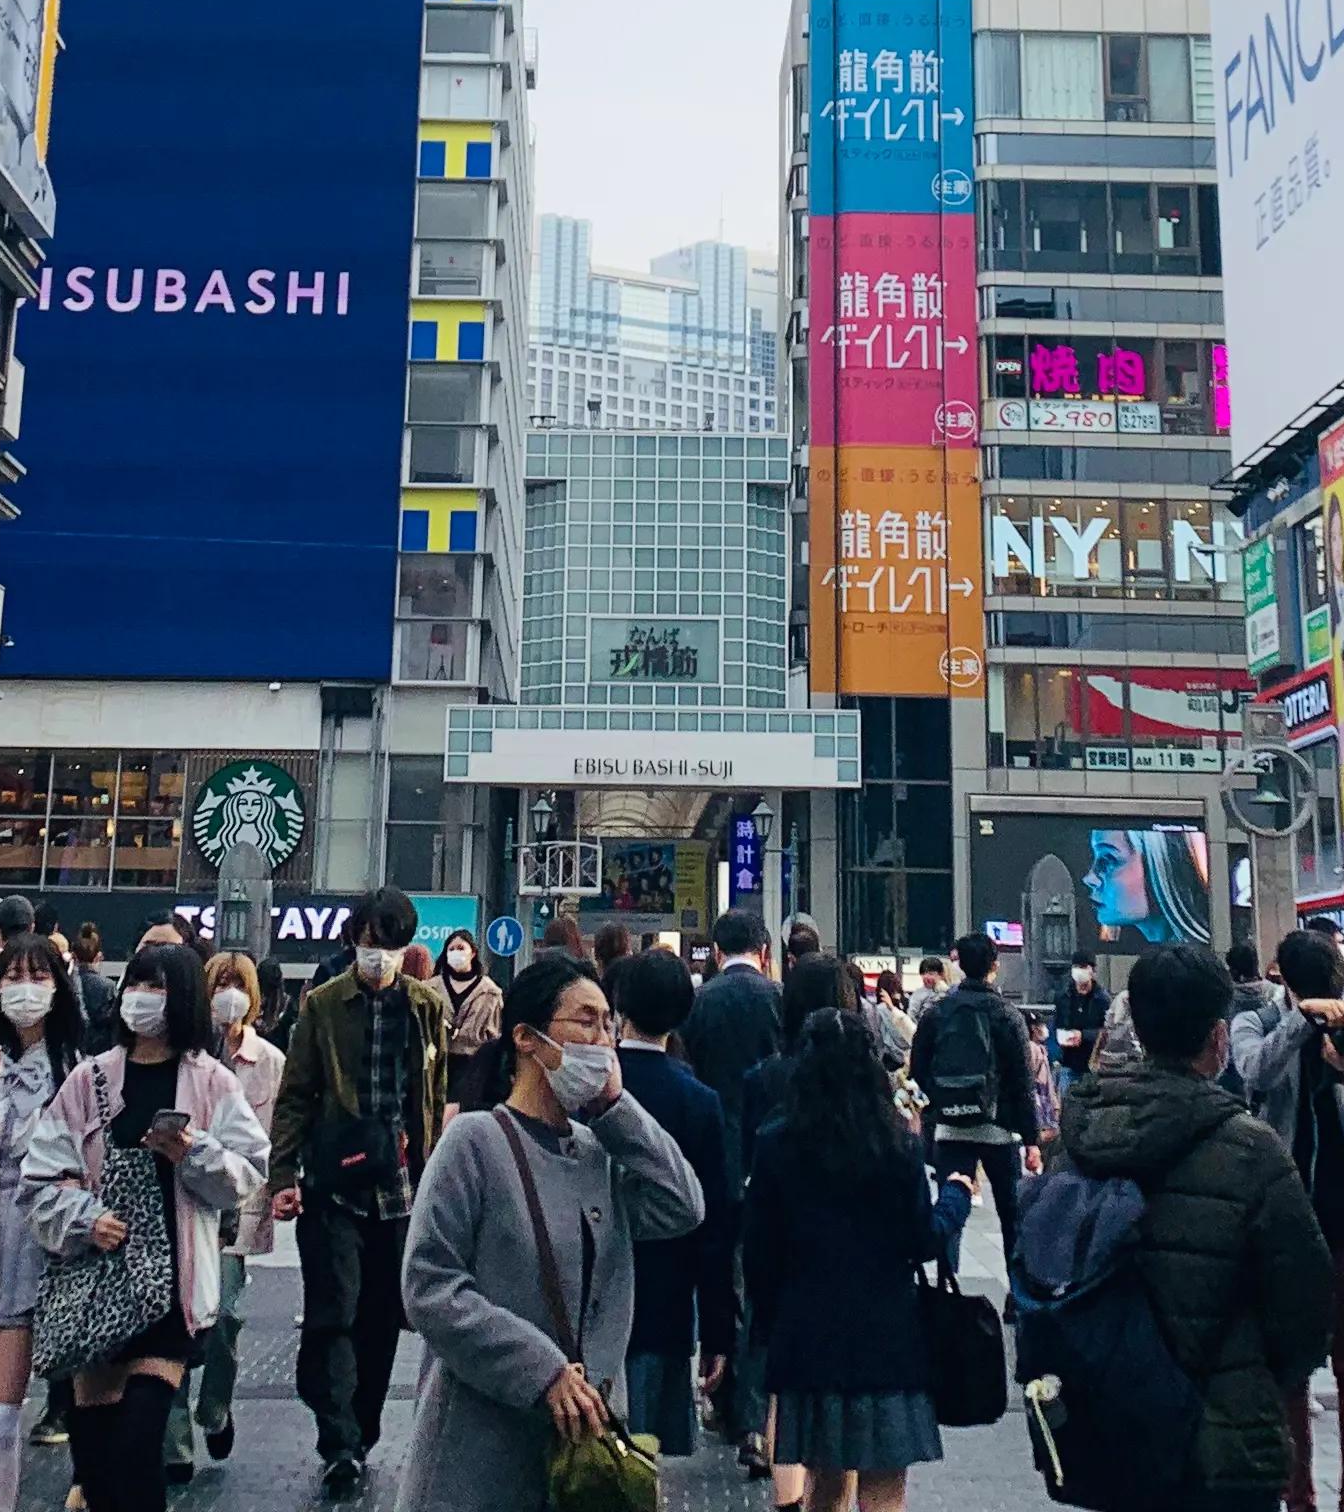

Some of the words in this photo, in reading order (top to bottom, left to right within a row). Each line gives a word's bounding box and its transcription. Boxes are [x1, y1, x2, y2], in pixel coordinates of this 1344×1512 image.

[839, 49, 945, 94] 龍角散
[840, 272, 948, 319] 龍角散
[1030, 343, 1146, 394] 焼肉
[840, 509, 952, 561] 龍角散
[993, 516, 1111, 579] NY
[629, 625, 681, 646] なんば
[610, 644, 699, 680] 戎橋筋
[1283, 679, 1331, 728] OTTERIA
[574, 757, 629, 776] EBISU
[1135, 756, 1152, 766] AM
[174, 906, 352, 940] TSAYA
[859, 958, 873, 969] NY
[877, 959, 892, 970] NY
